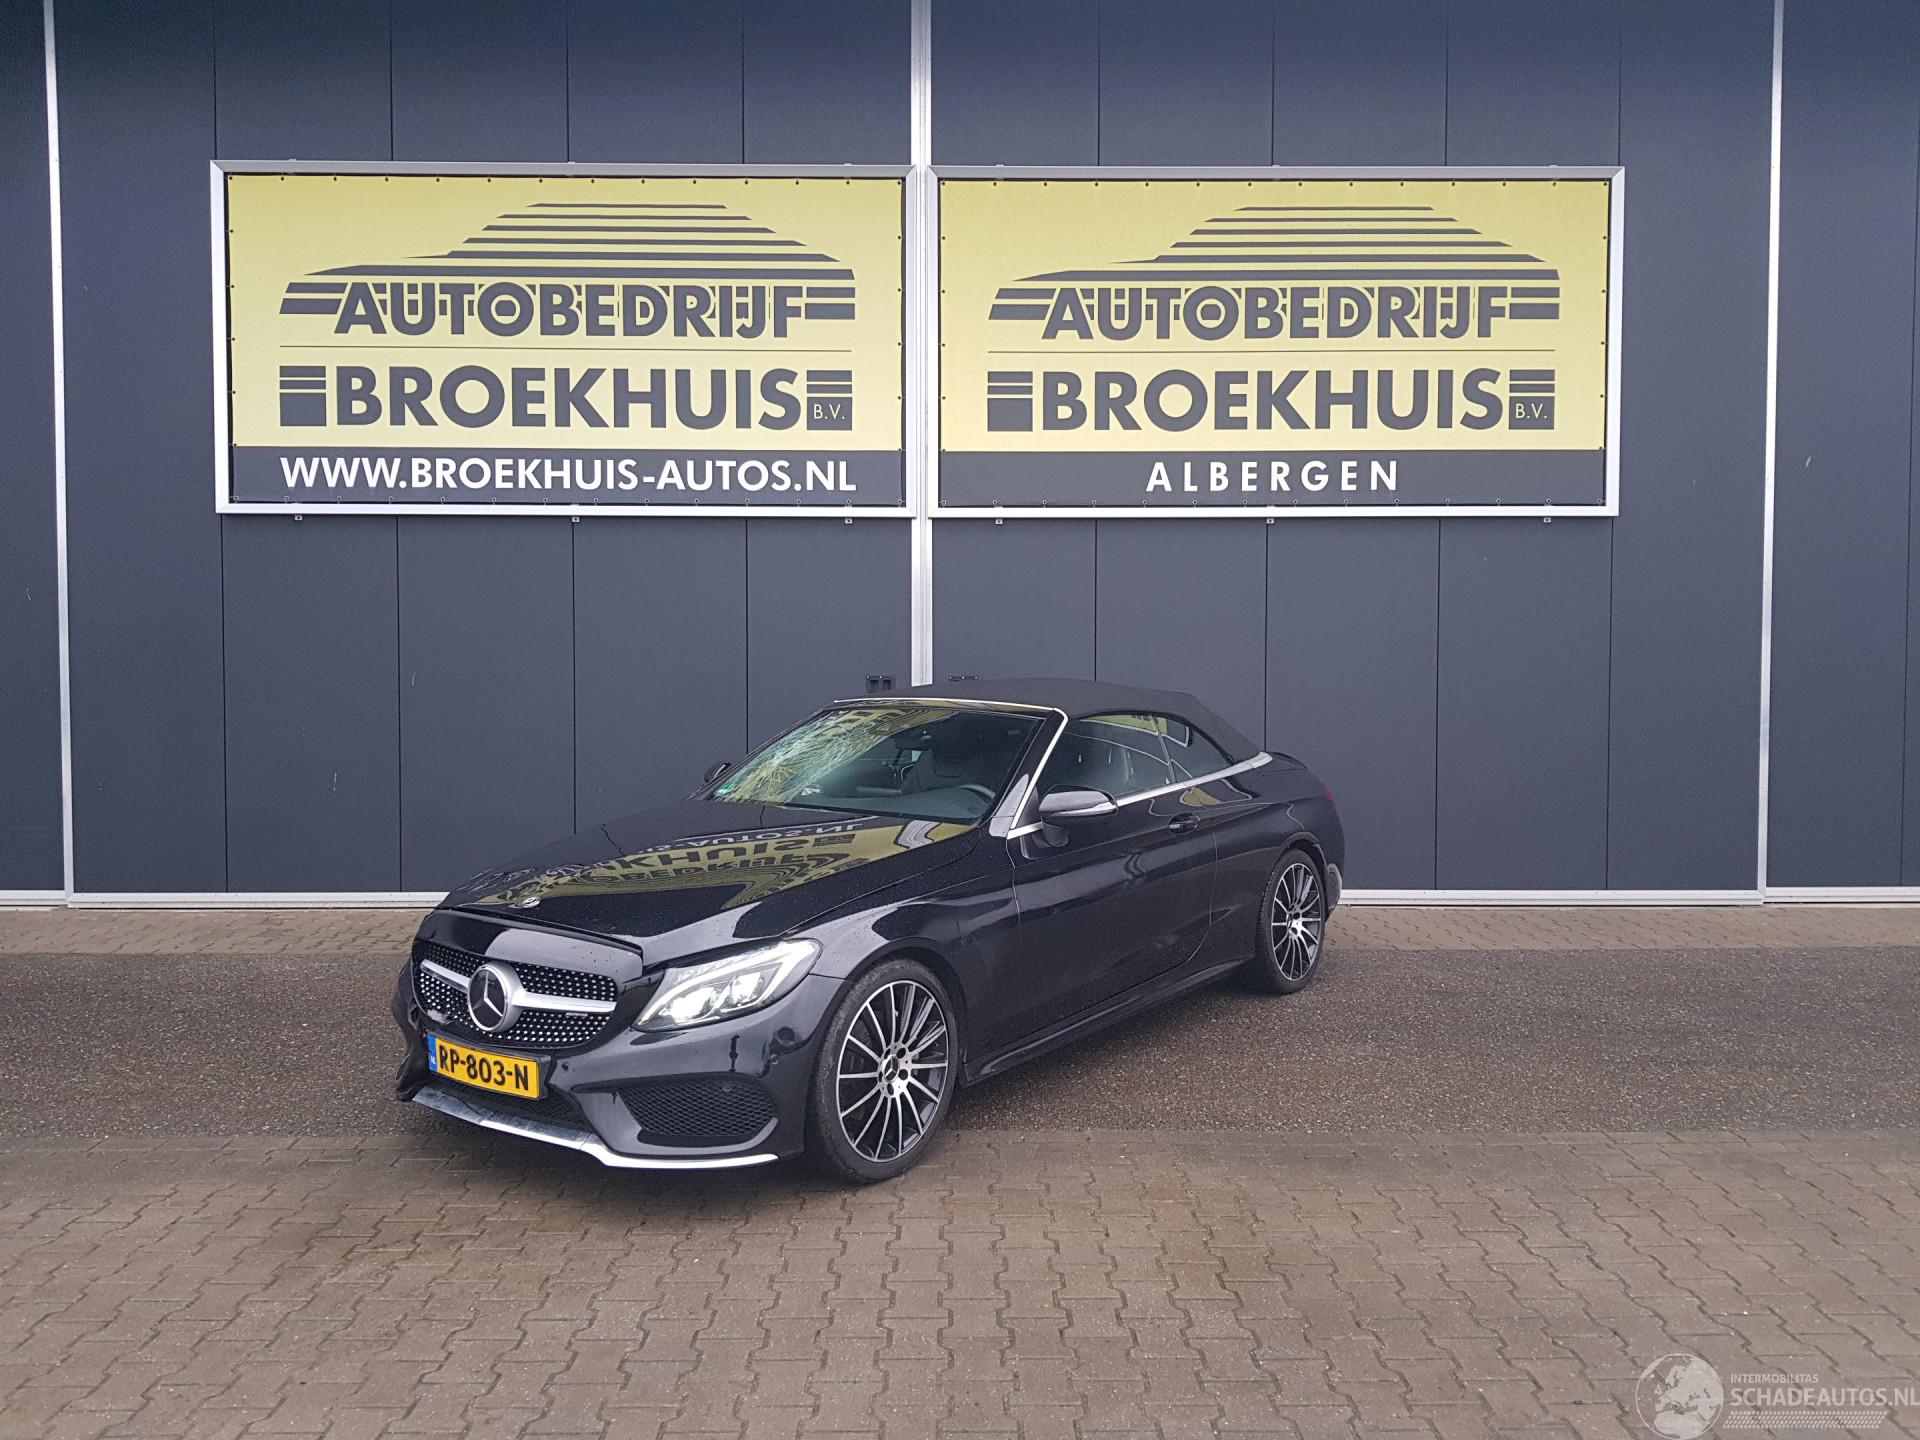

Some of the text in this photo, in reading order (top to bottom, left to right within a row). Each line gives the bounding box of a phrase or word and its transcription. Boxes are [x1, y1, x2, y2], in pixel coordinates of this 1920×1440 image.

[334, 281, 805, 339] AUTOBEDRIJF
[1041, 285, 1508, 341] AUTOBEDRIJF
[336, 364, 846, 431] BROEKHUIS B.V.
[1042, 368, 1548, 432] BROEKHUIS B.V.
[280, 457, 857, 493] WWW.BROEKHUIS-AUTOS.NL
[1145, 460, 1399, 493] ALBERGEN
[439, 1044, 529, 1091] RP-803-N
